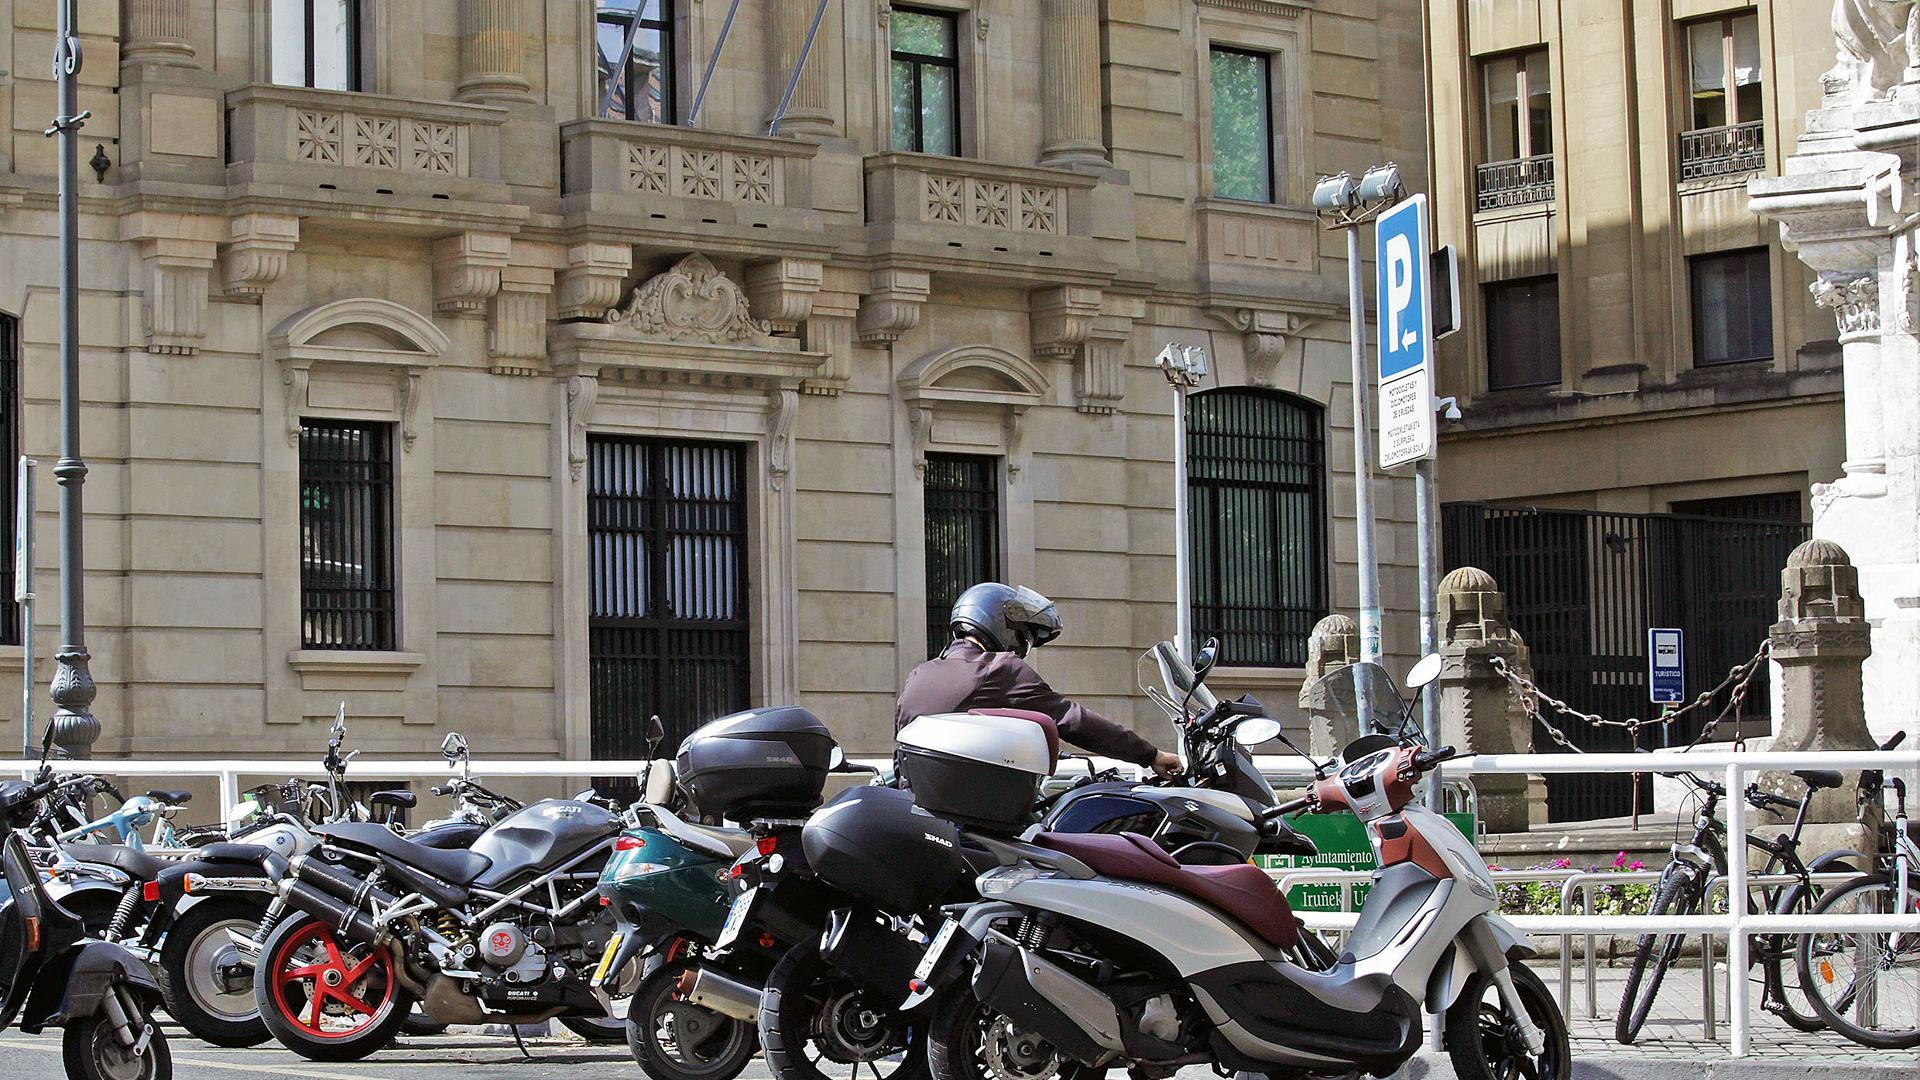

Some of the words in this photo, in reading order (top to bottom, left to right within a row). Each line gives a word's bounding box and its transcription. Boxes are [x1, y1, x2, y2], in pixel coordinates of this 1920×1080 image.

[1387, 233, 1412, 353] P
[1655, 669, 1681, 677] TURÍSTICO
[924, 832, 953, 848] SHAD
[1301, 850, 1373, 868] Ayuntamiento
[1302, 890, 1342, 907] Iruñek
